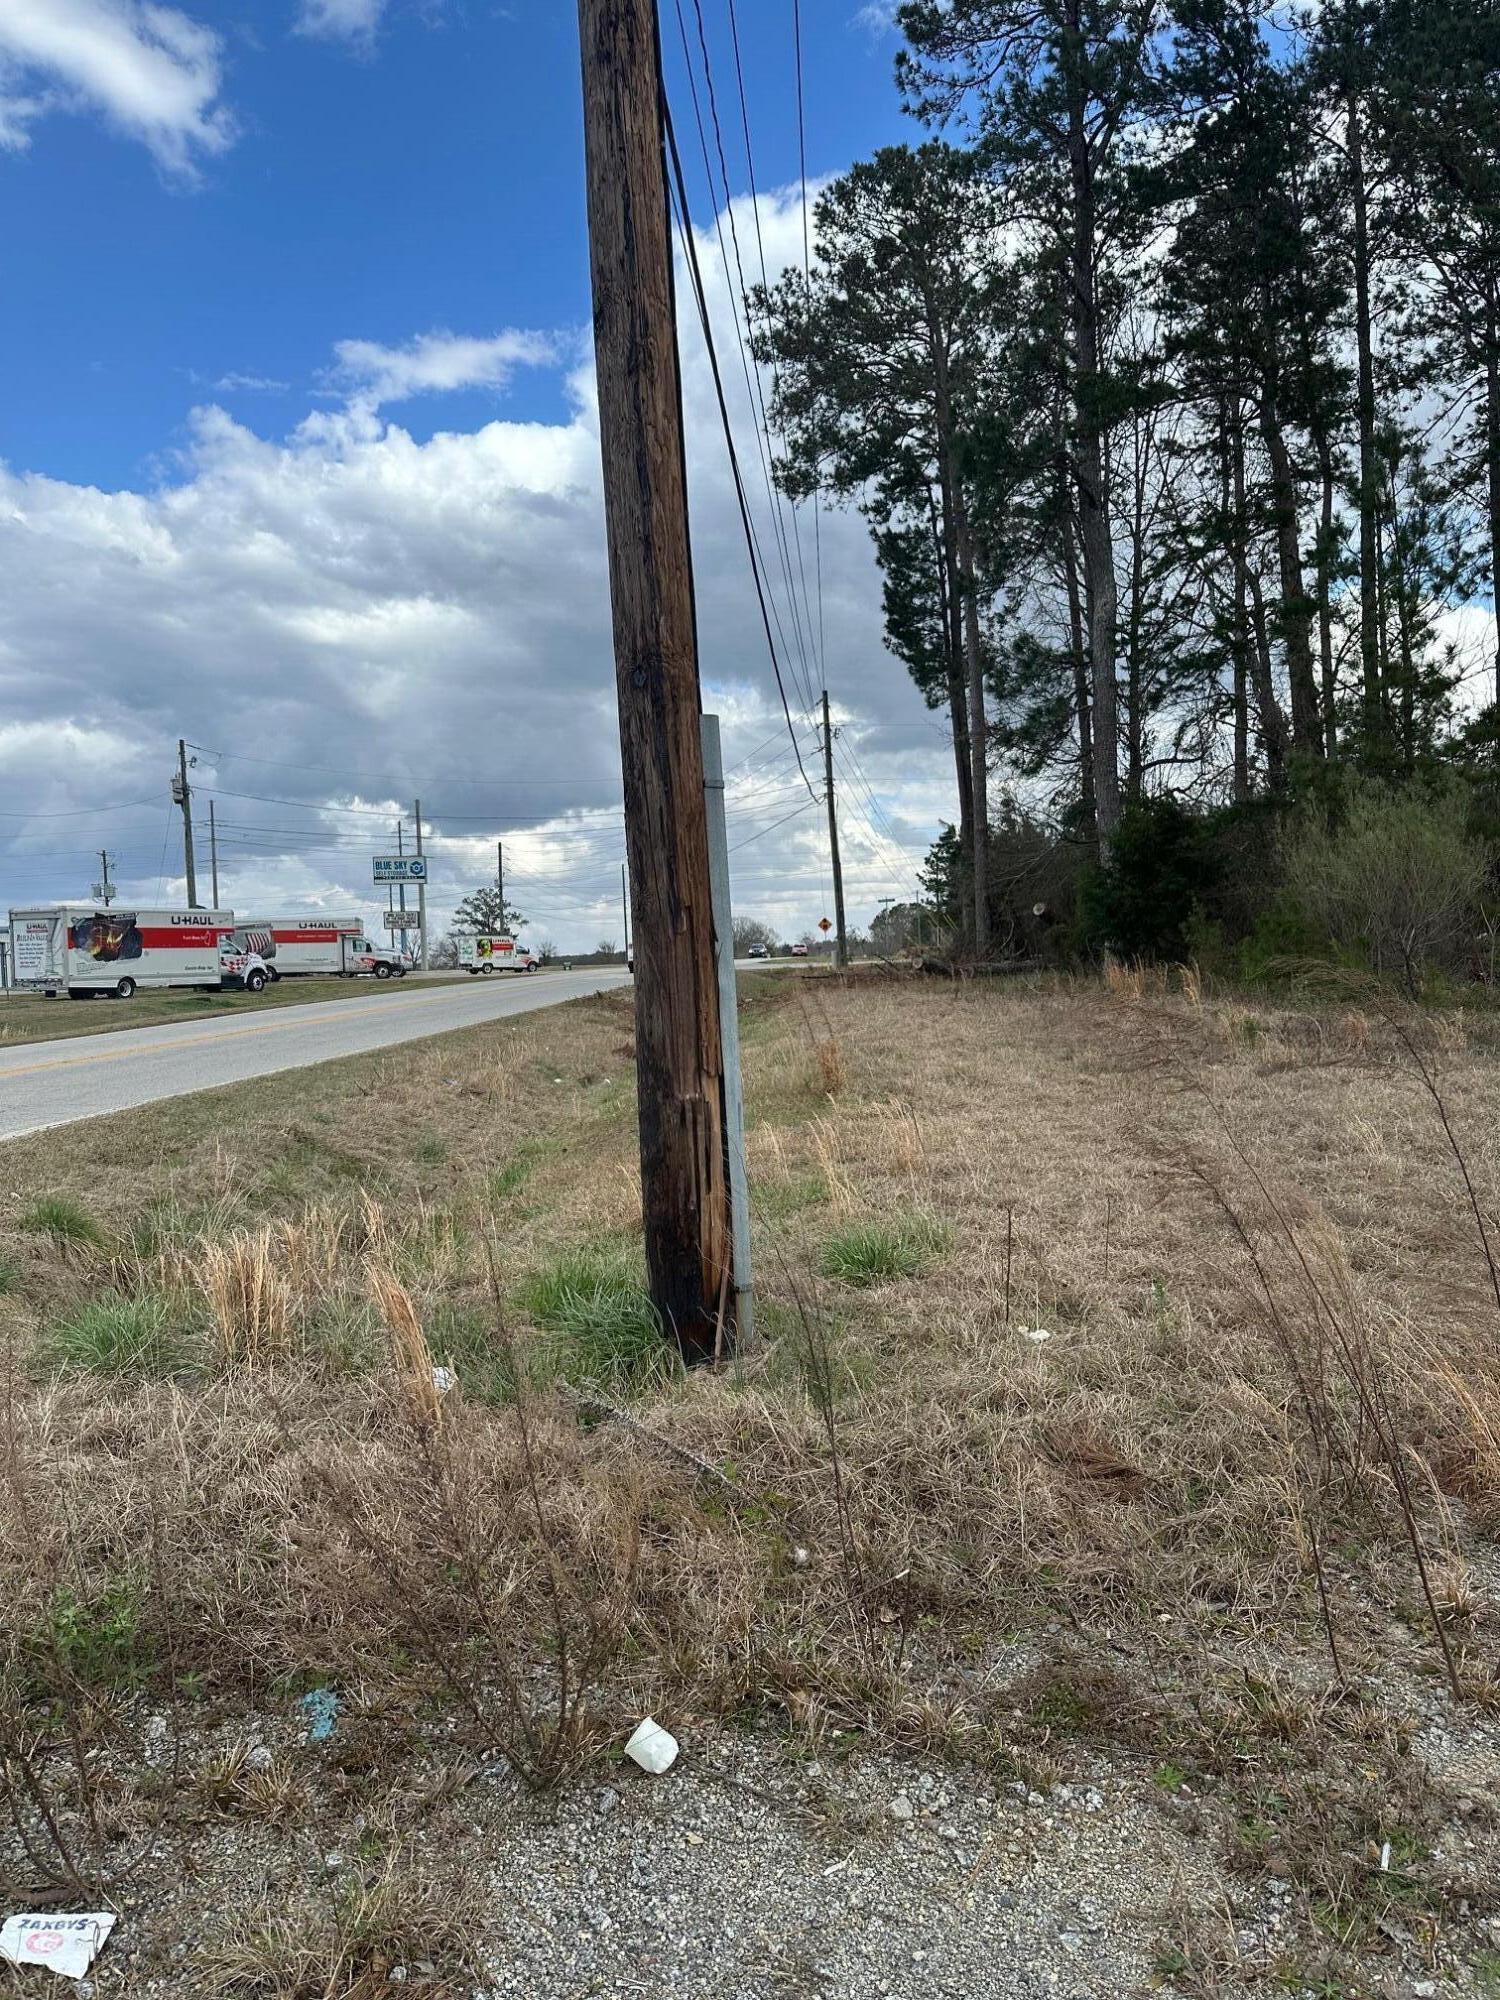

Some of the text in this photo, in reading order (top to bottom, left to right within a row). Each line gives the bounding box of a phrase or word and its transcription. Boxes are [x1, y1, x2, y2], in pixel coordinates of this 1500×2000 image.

[375, 861, 408, 870] BLUE SKY
[171, 916, 214, 925] U-HAUL
